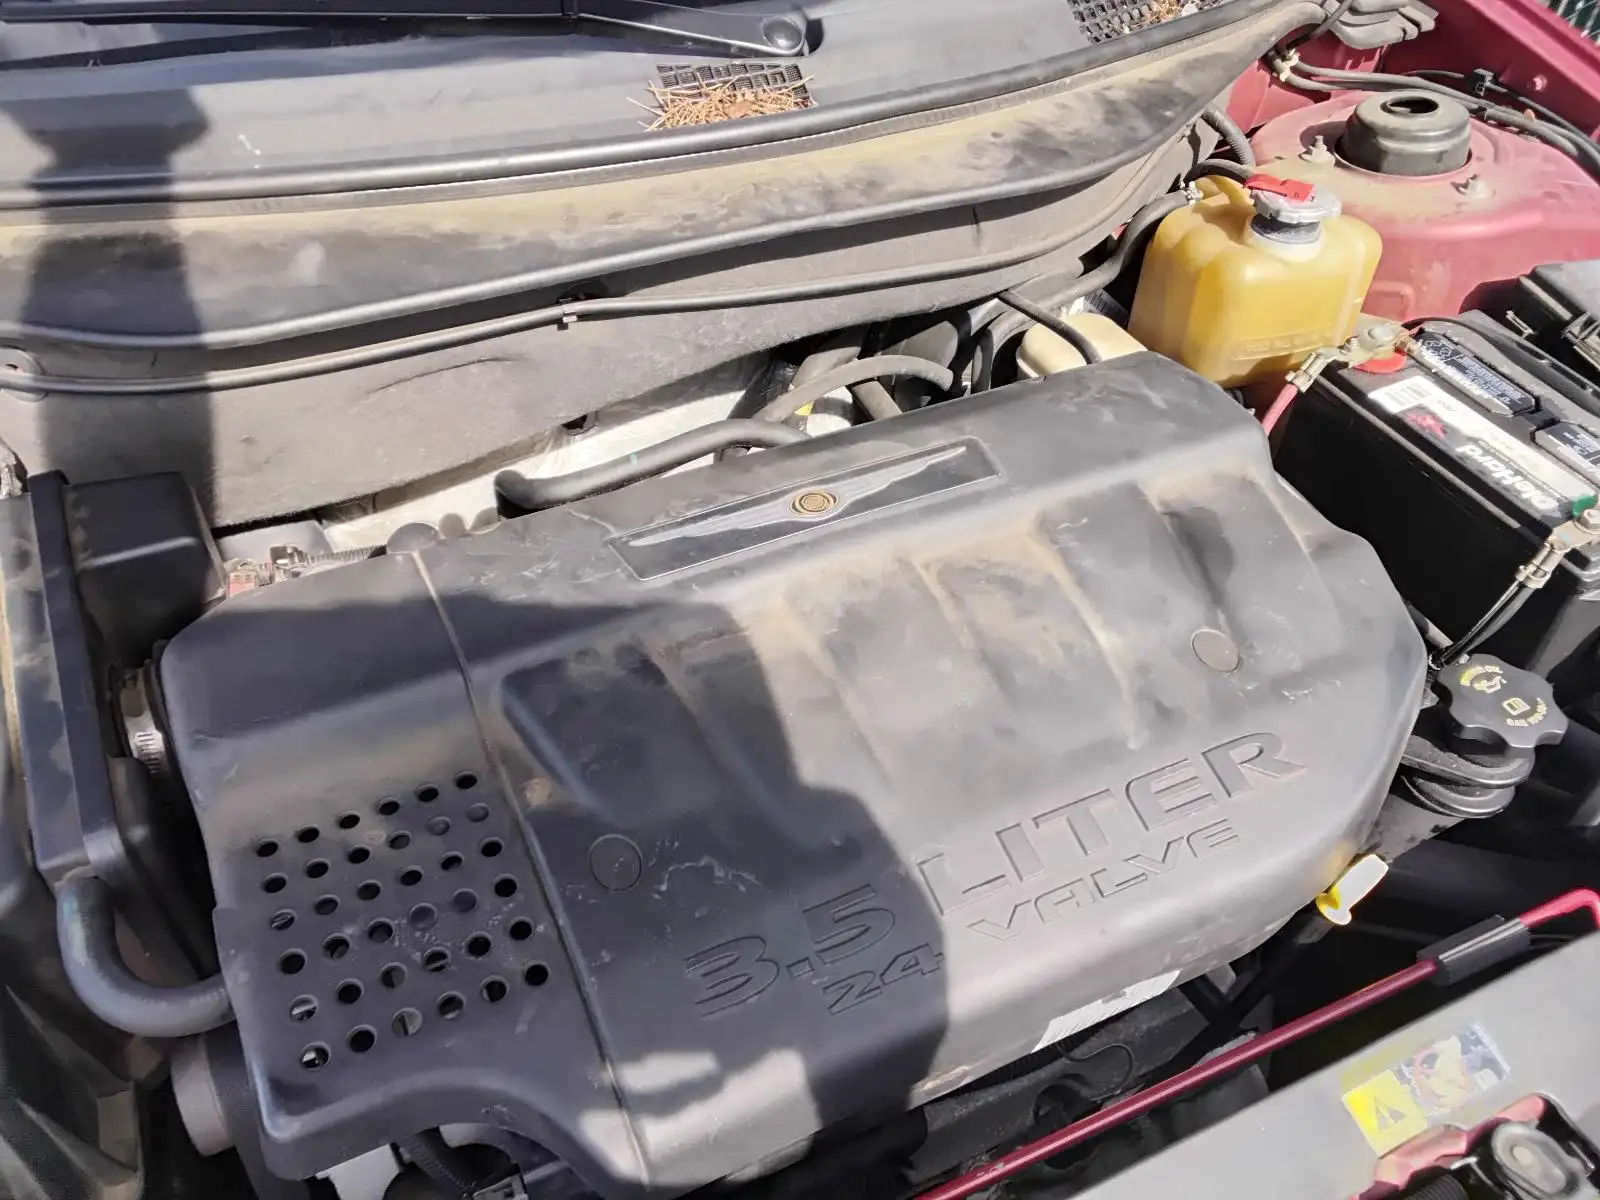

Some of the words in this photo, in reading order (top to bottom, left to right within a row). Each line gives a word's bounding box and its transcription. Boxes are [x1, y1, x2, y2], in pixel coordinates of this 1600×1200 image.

[684, 883, 895, 1017] 3.5
[917, 732, 1306, 915] LITER
[822, 942, 945, 1015] 24
[966, 818, 1239, 940] VALVE
